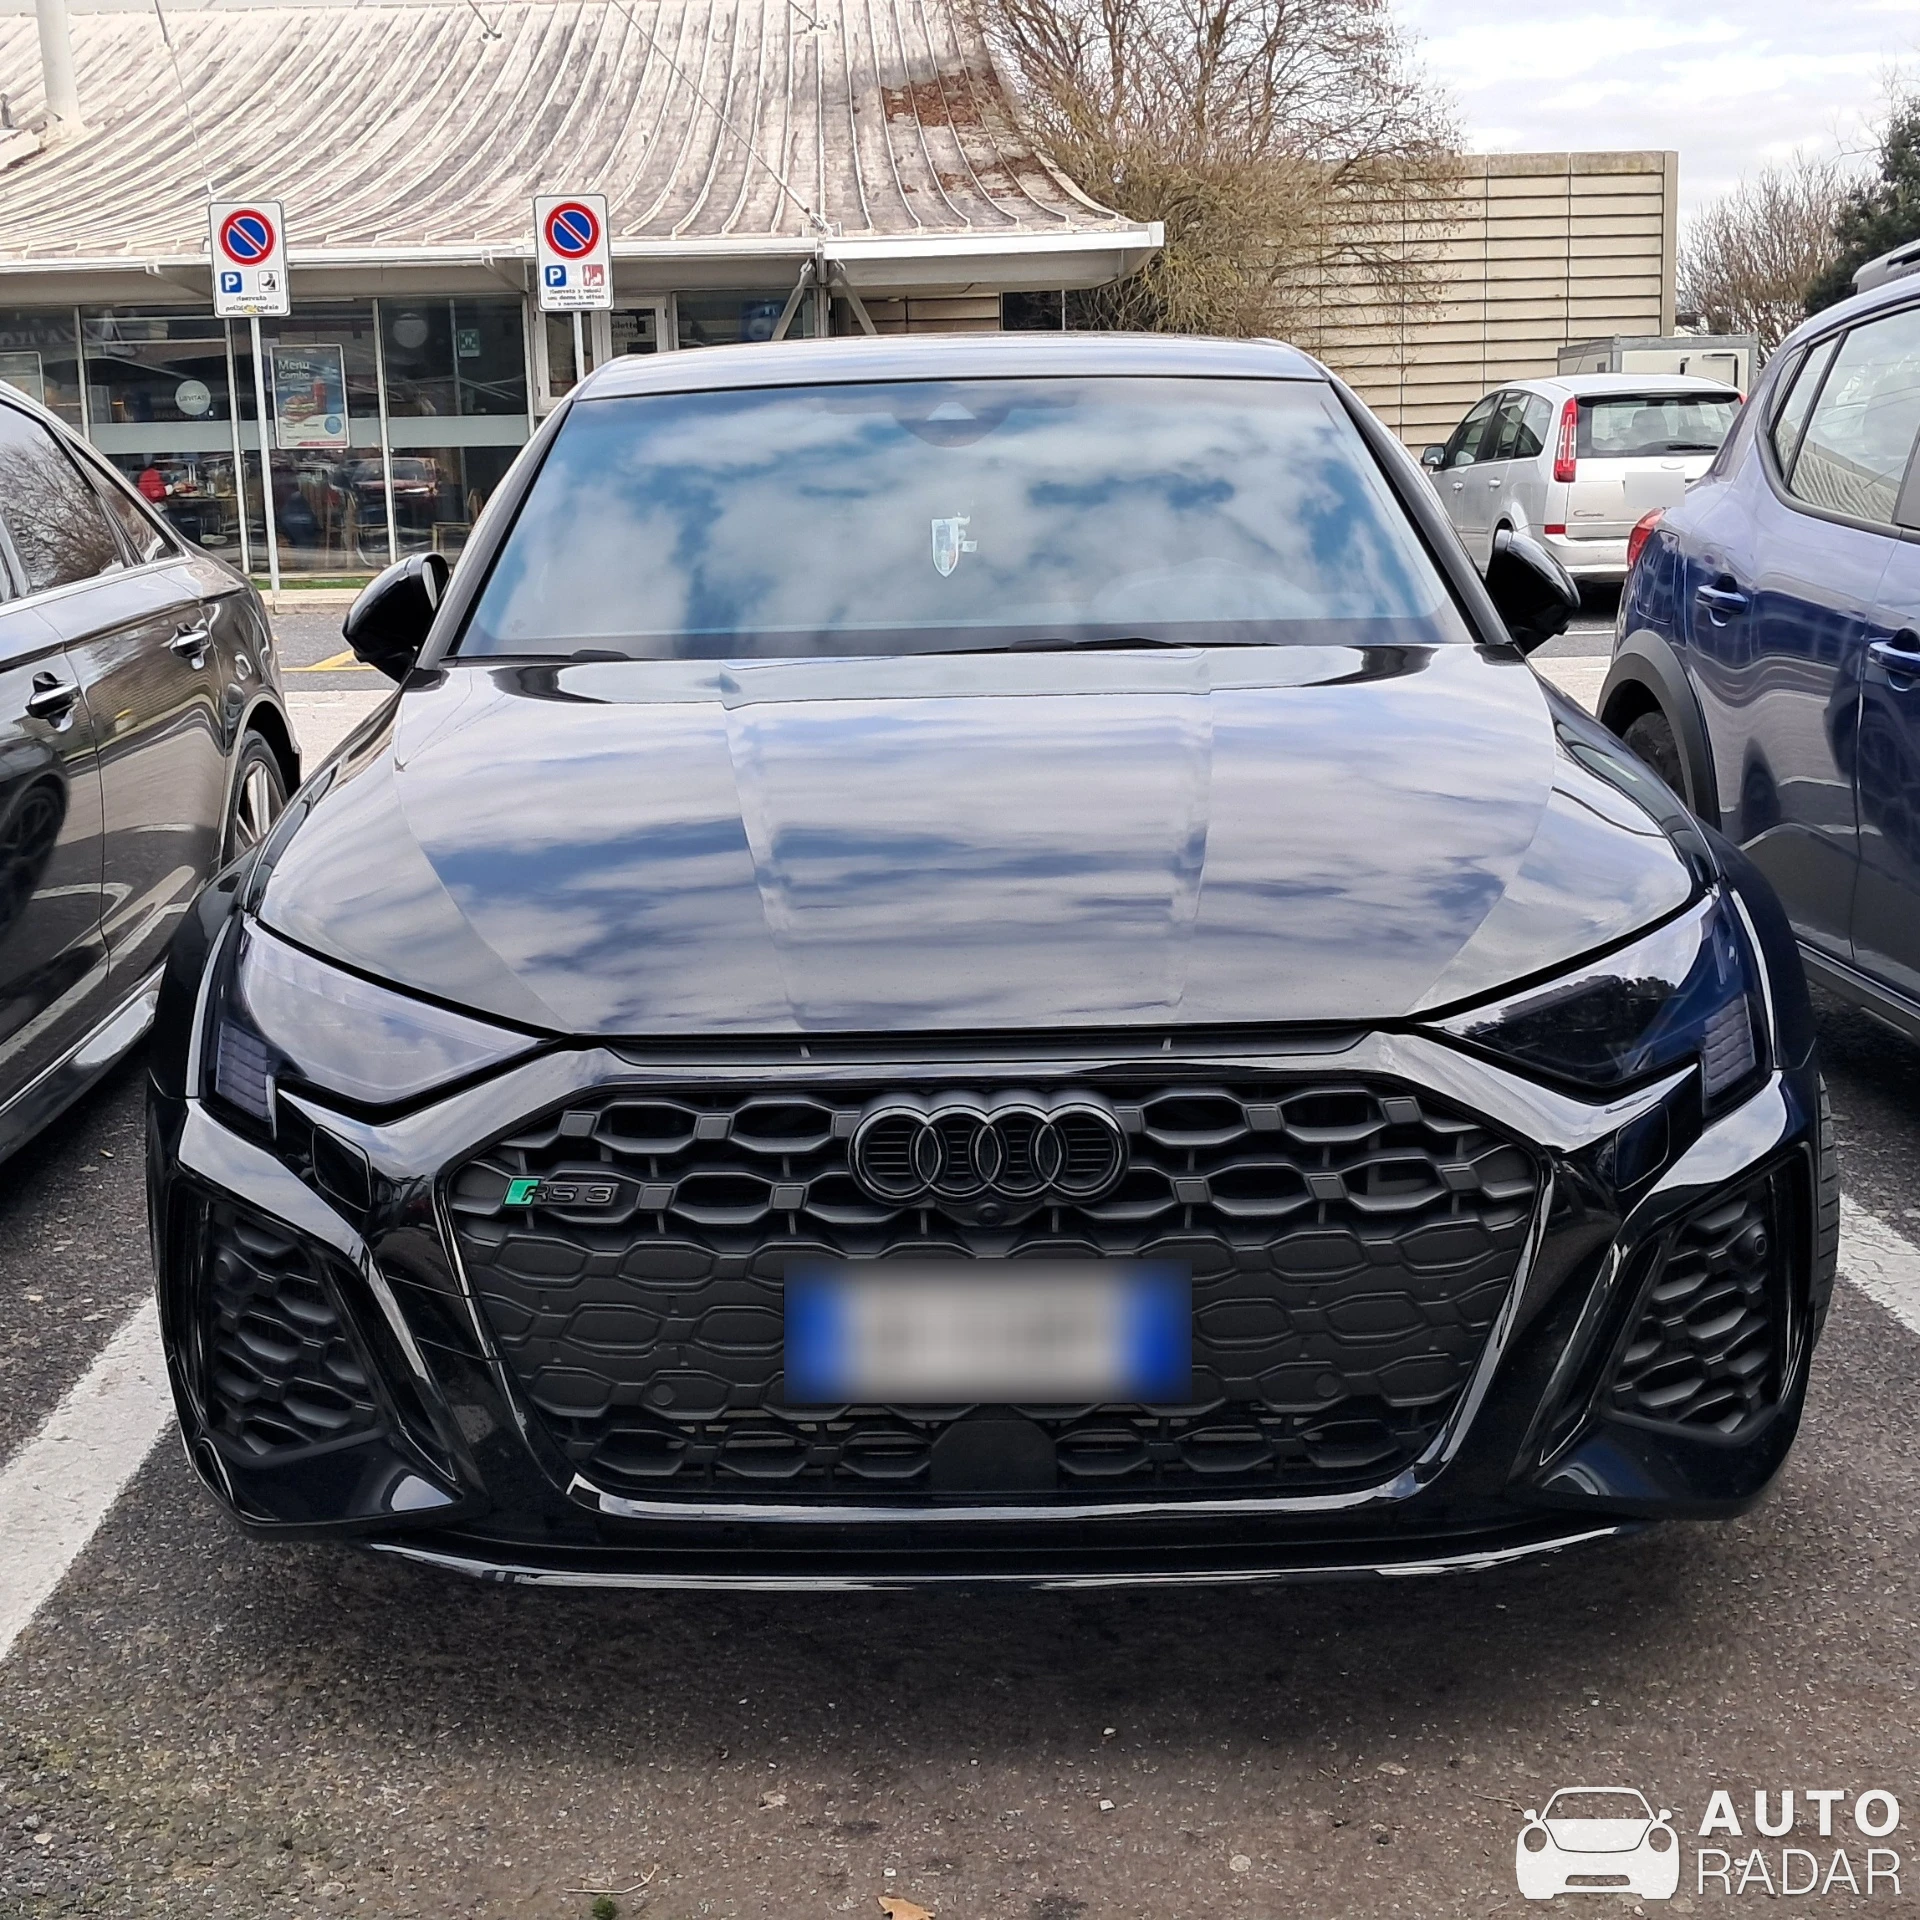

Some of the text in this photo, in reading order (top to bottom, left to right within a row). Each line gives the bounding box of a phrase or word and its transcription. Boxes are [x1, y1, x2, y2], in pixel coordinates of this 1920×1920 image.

[549, 268, 562, 285] P
[224, 274, 238, 291] P
[611, 321, 638, 330] oilette
[278, 359, 310, 370] Menu
[279, 370, 310, 380] Combo
